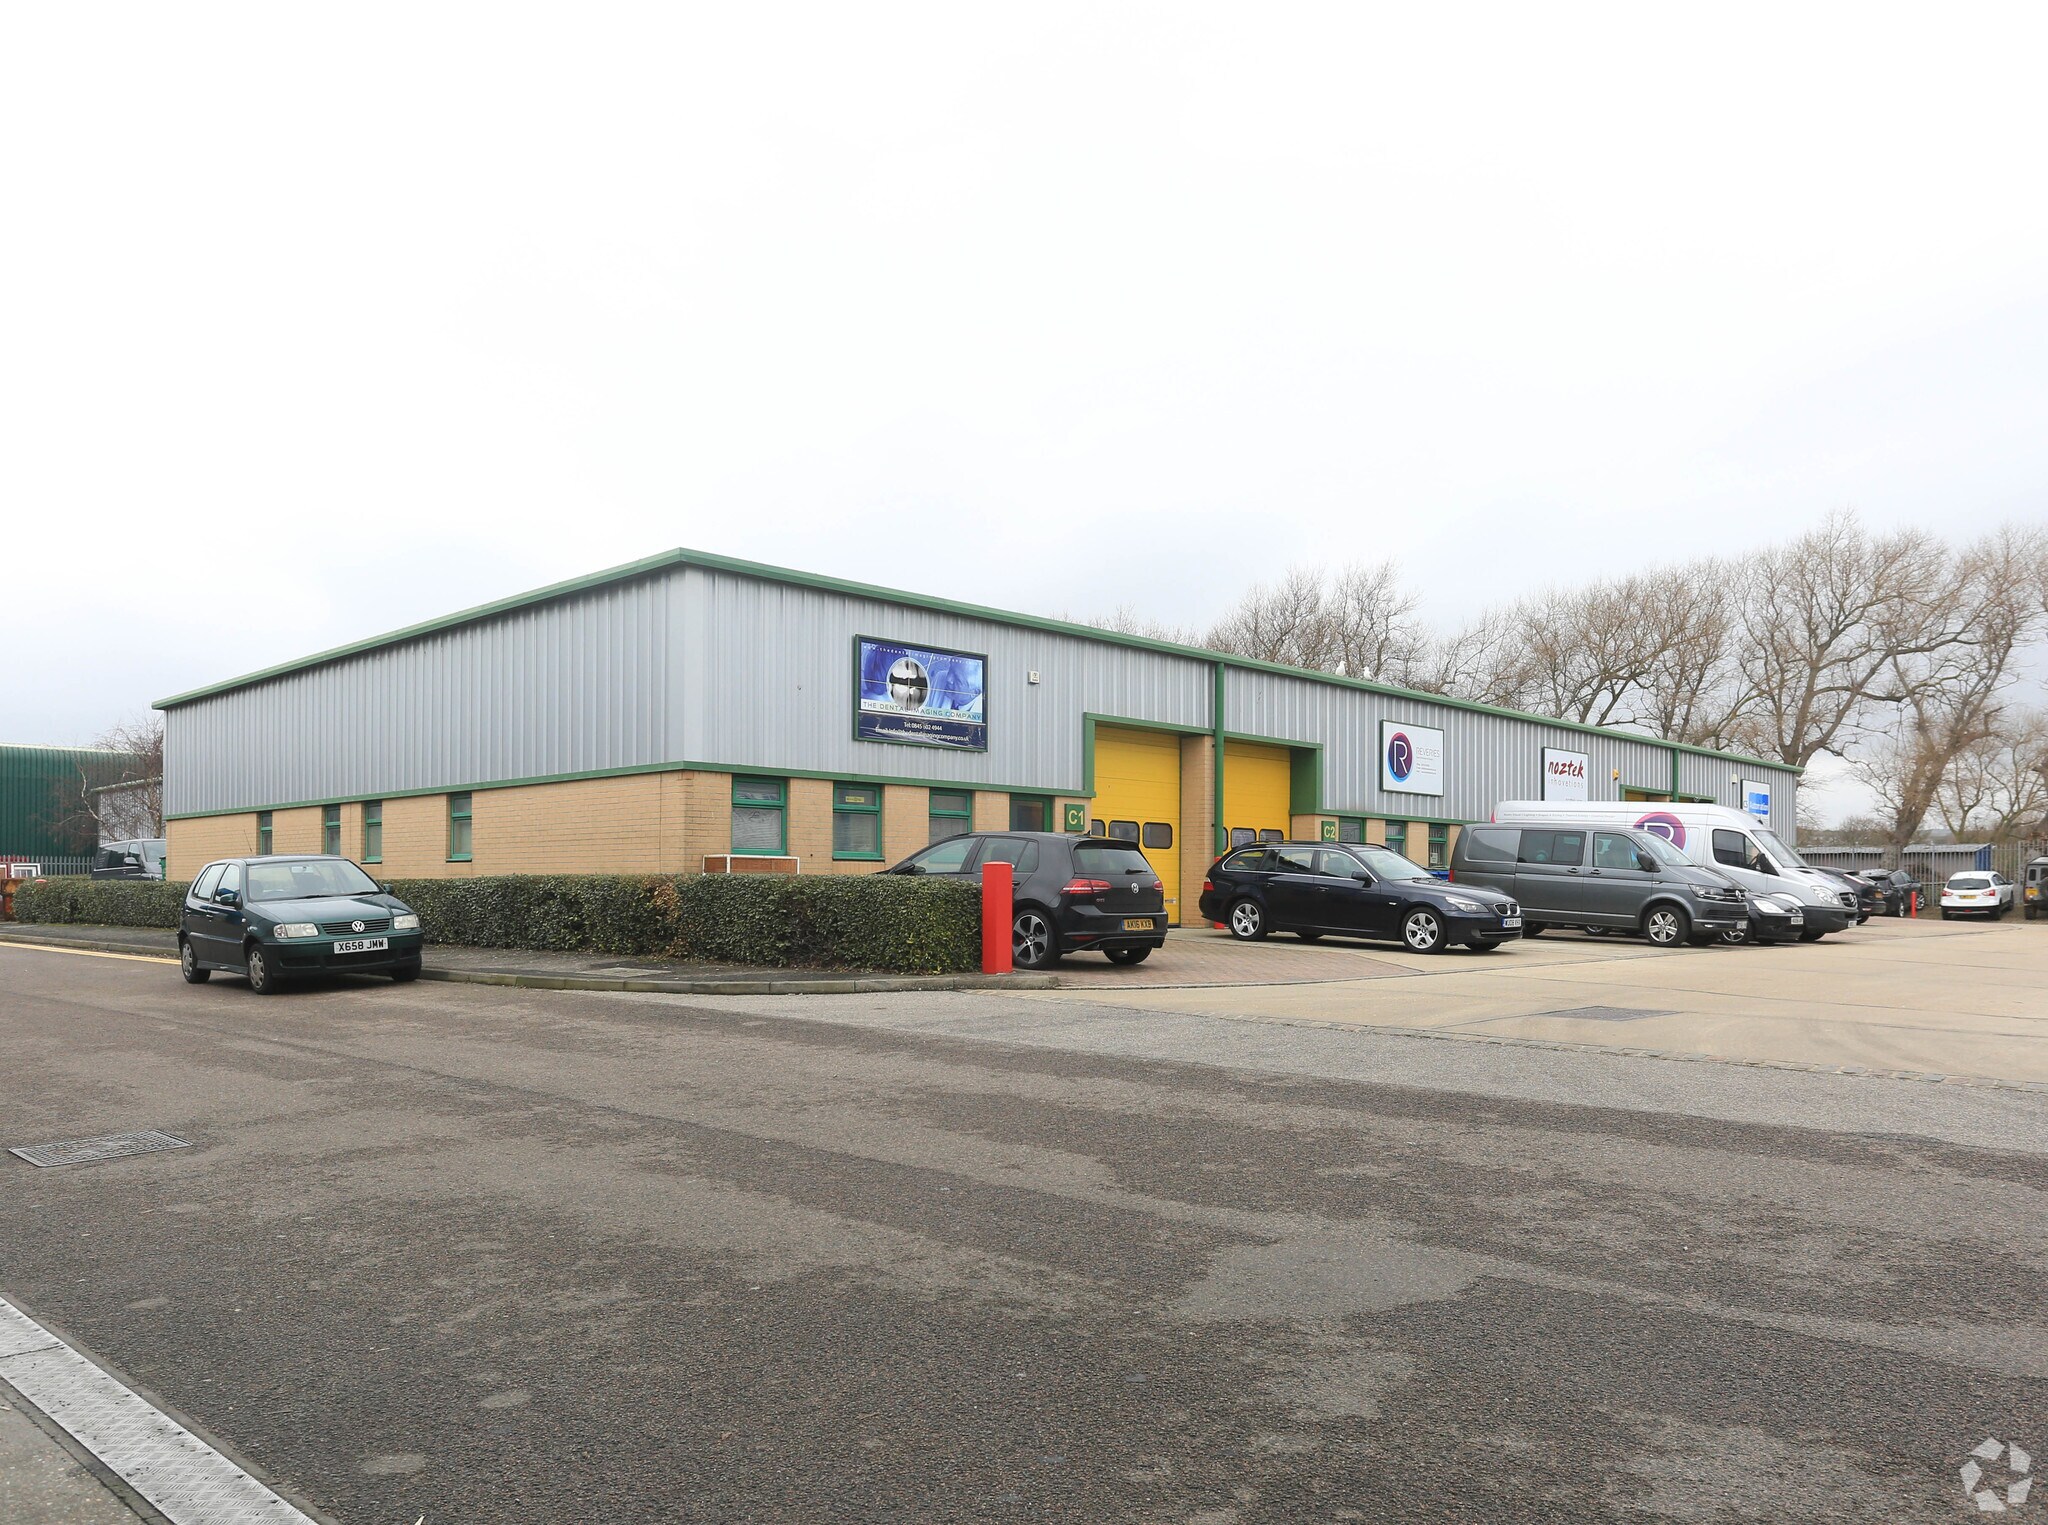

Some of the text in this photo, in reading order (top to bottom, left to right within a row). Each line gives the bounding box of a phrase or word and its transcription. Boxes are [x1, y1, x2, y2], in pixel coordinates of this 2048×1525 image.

[863, 701, 981, 720] THE DENTAL IMAGING COMPANY
[1548, 760, 1584, 779] noztek
[1068, 809, 1084, 826] C1
[1324, 825, 1336, 838] C2
[338, 939, 384, 952] X658 JMW
